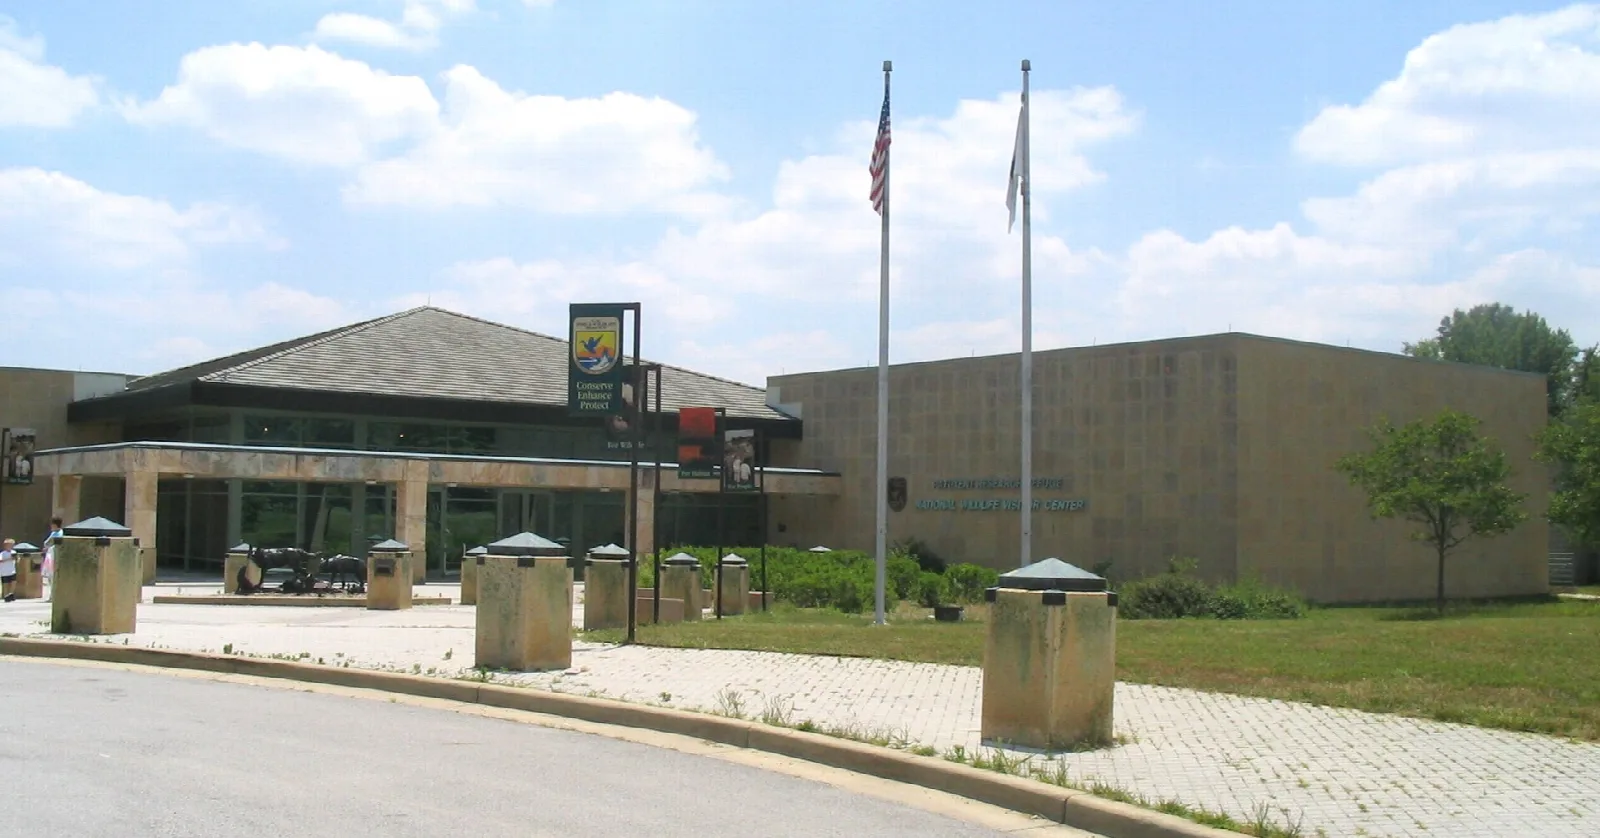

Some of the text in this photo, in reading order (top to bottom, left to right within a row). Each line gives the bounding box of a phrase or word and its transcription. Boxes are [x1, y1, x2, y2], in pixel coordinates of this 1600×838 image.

[576, 381, 614, 390] Conserve
[577, 391, 612, 400] Enhance
[580, 401, 609, 410] Protect
[916, 499, 1085, 512] NATIONAL WILDLIFE VISIR CENTER
